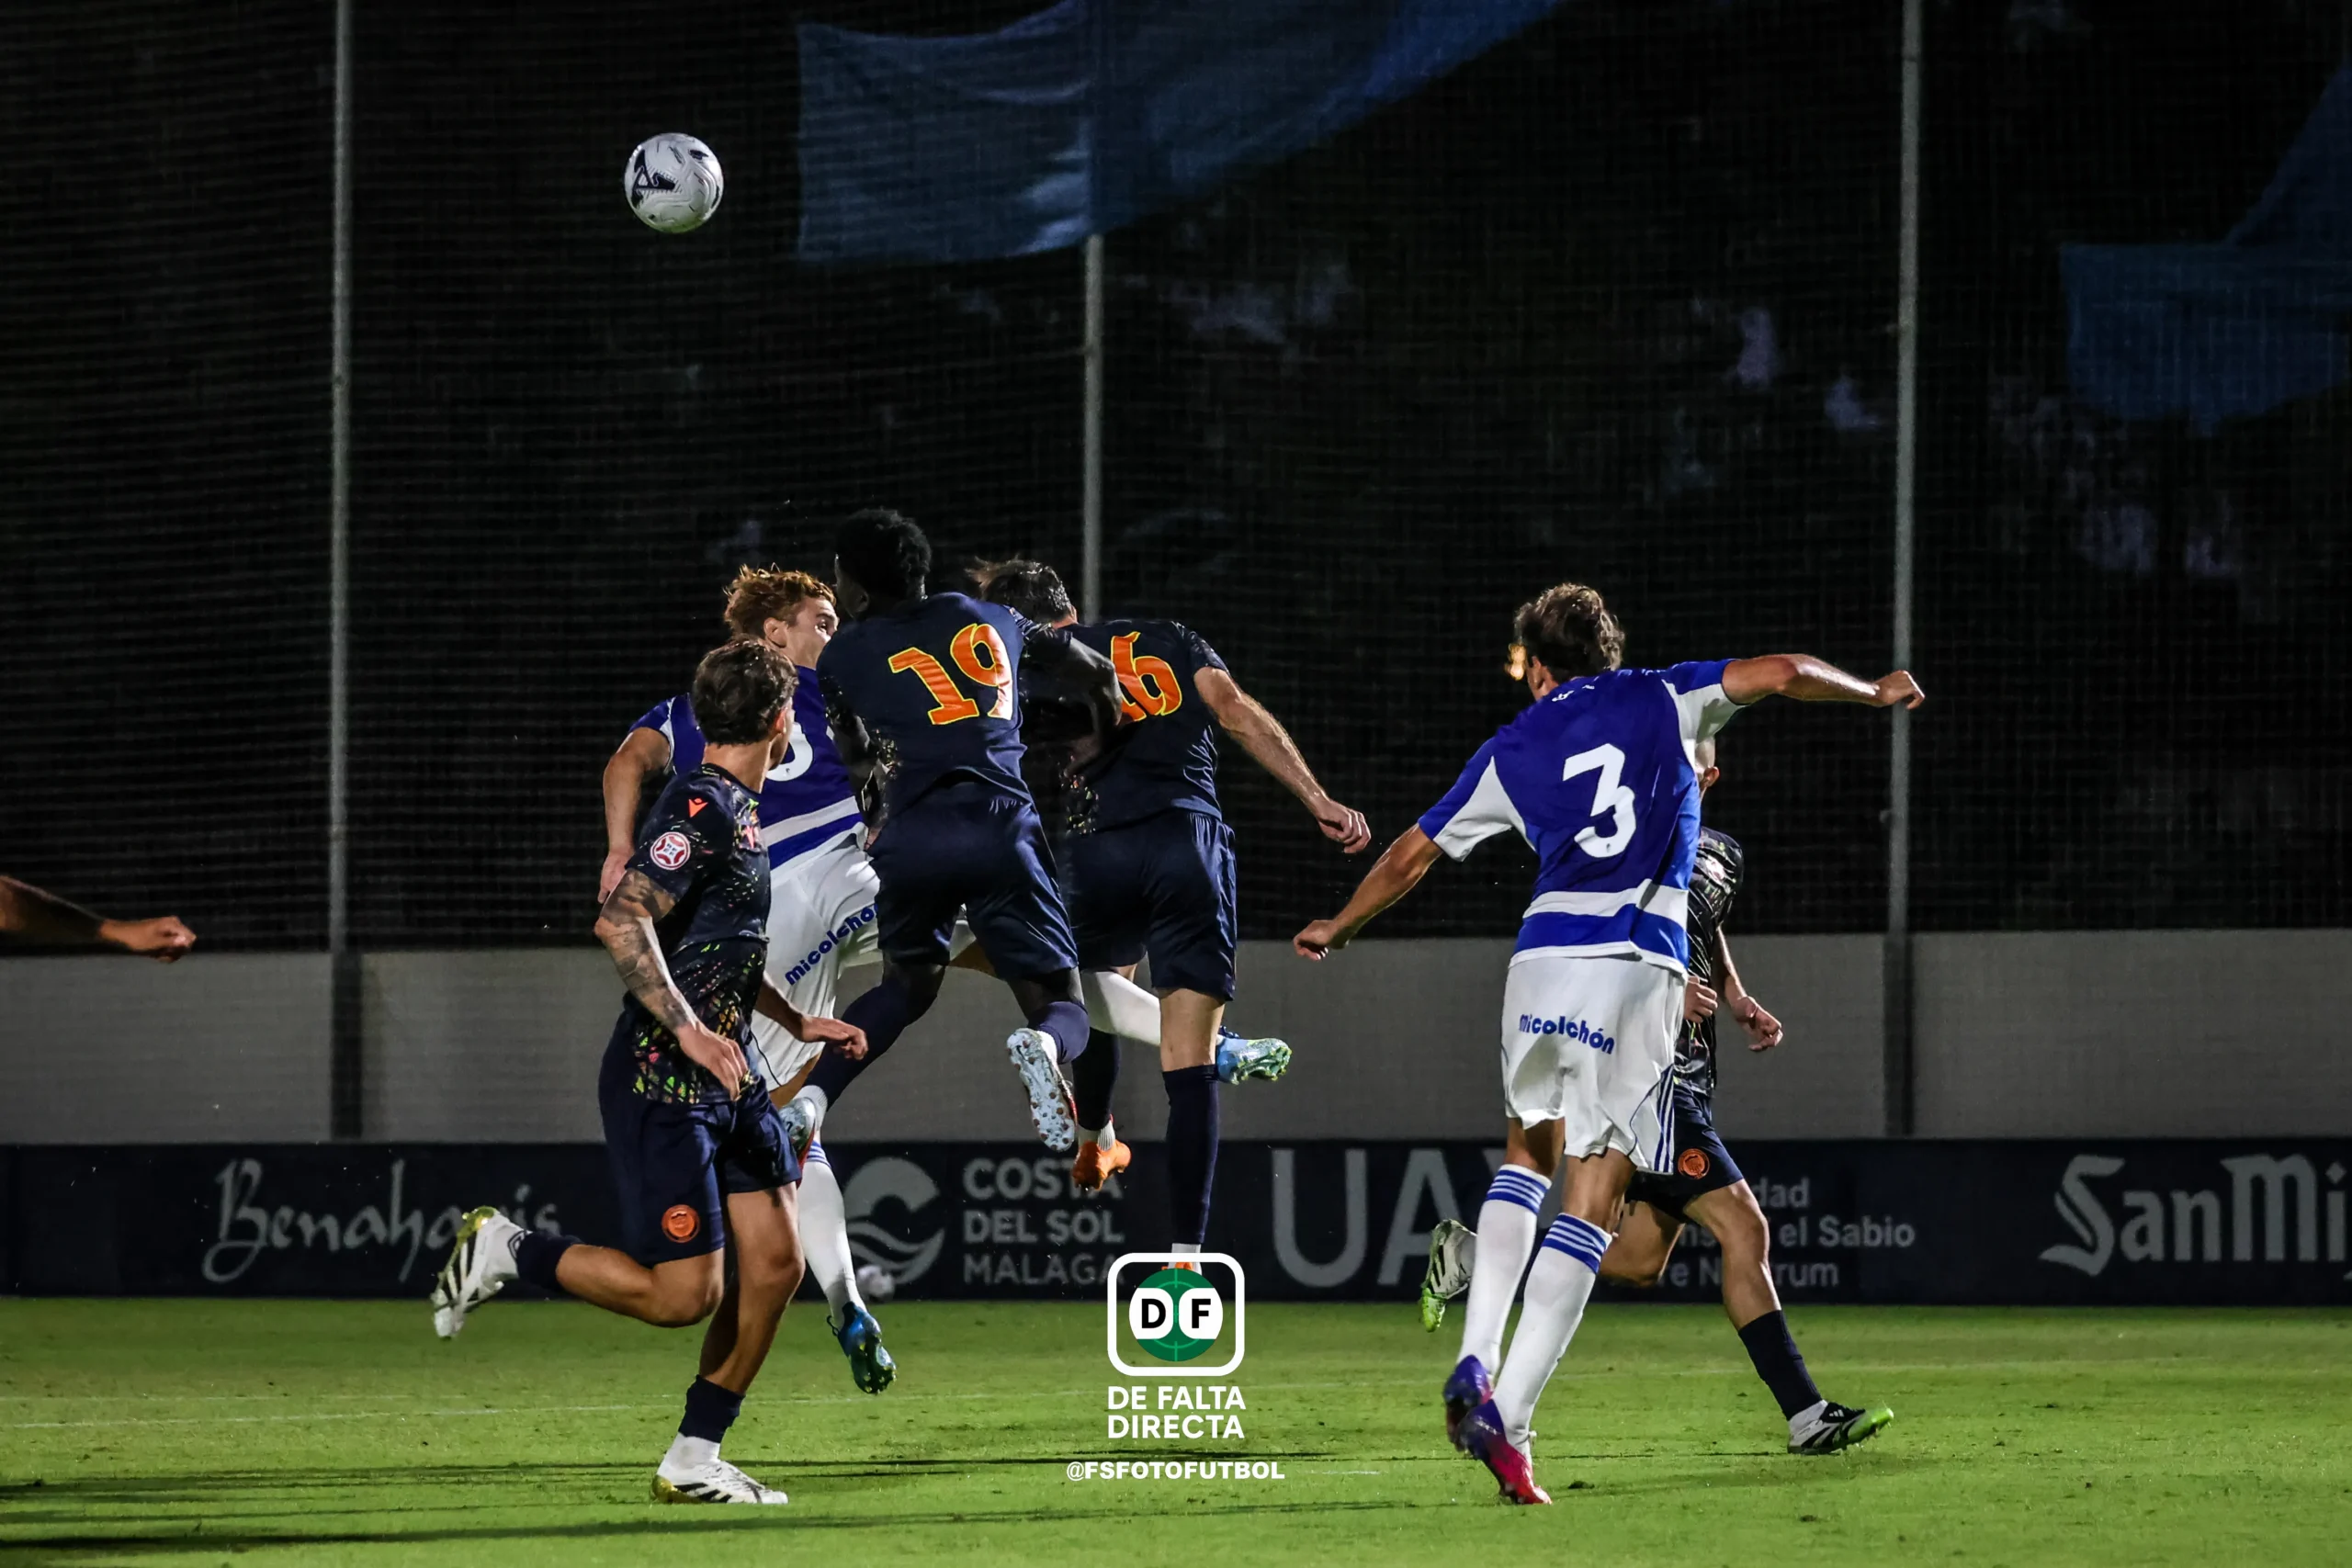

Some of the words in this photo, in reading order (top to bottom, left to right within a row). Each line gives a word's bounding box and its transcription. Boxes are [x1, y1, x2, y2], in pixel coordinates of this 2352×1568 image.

[888, 623, 1012, 725] 19
[1562, 743, 1637, 858] 3
[1519, 1013, 1615, 1055] micolchón
[201, 1157, 562, 1282] Benahais
[964, 1210, 1038, 1243] DEL
[1046, 1209, 1125, 1244] SOL
[1779, 1216, 1807, 1247] el
[1818, 1214, 1917, 1247] Sabio
[2039, 1154, 2352, 1280] SanMi
